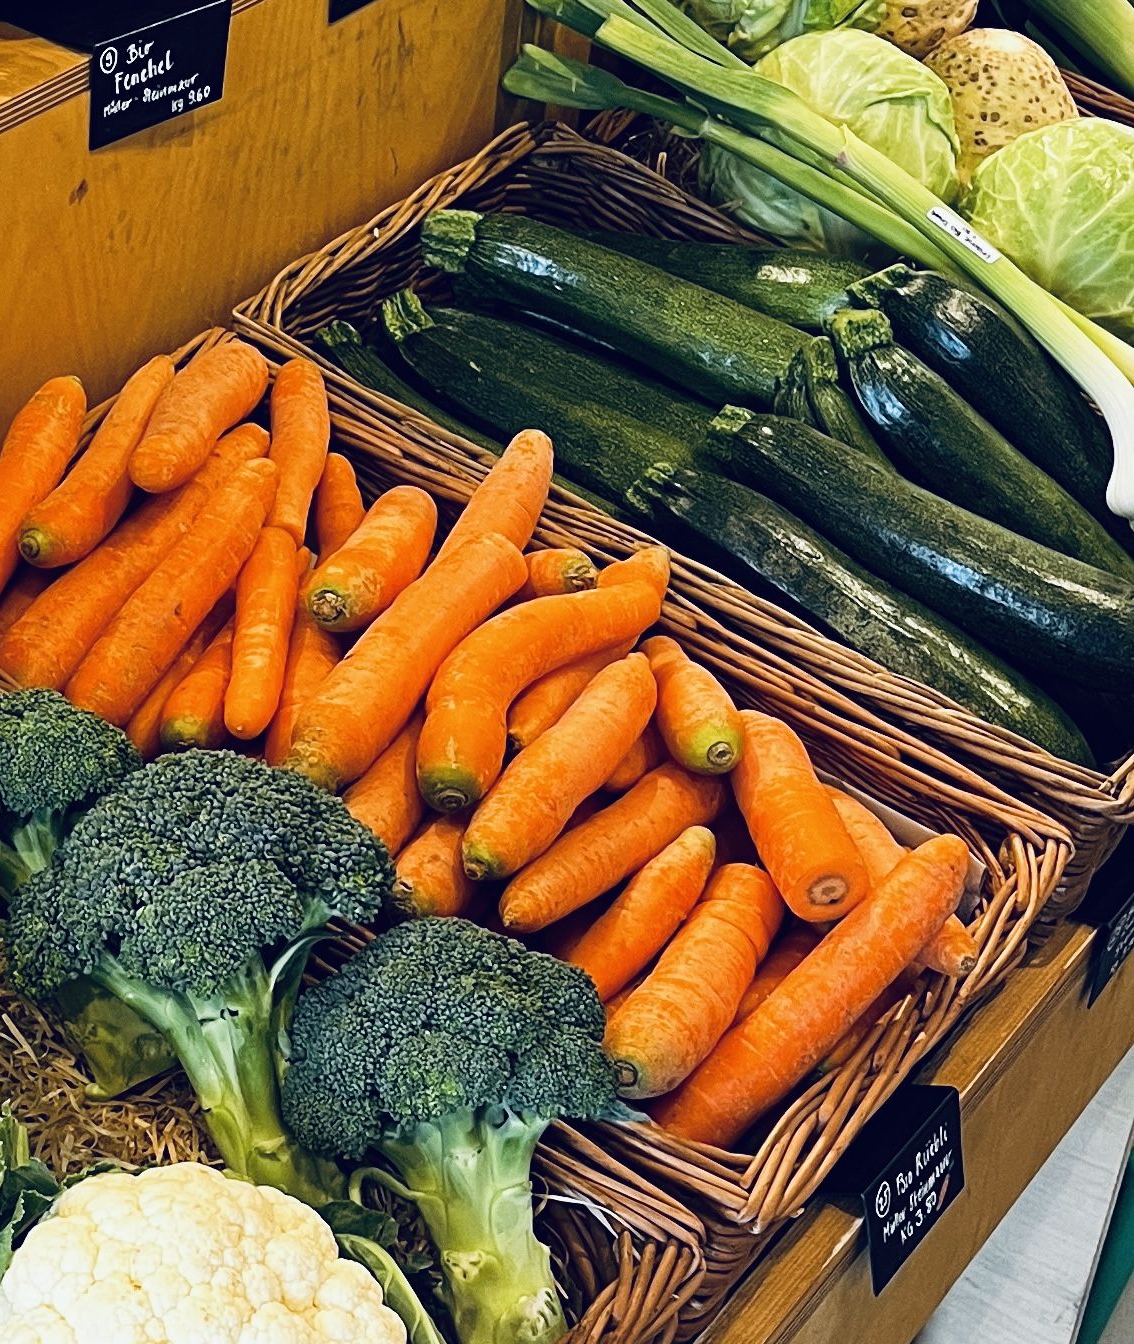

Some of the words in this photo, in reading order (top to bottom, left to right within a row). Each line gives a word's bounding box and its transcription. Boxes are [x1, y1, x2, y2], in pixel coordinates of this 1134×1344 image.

[126, 40, 154, 64] Bio
[114, 50, 174, 94] Fenchel
[896, 1170, 913, 1196] Bio
